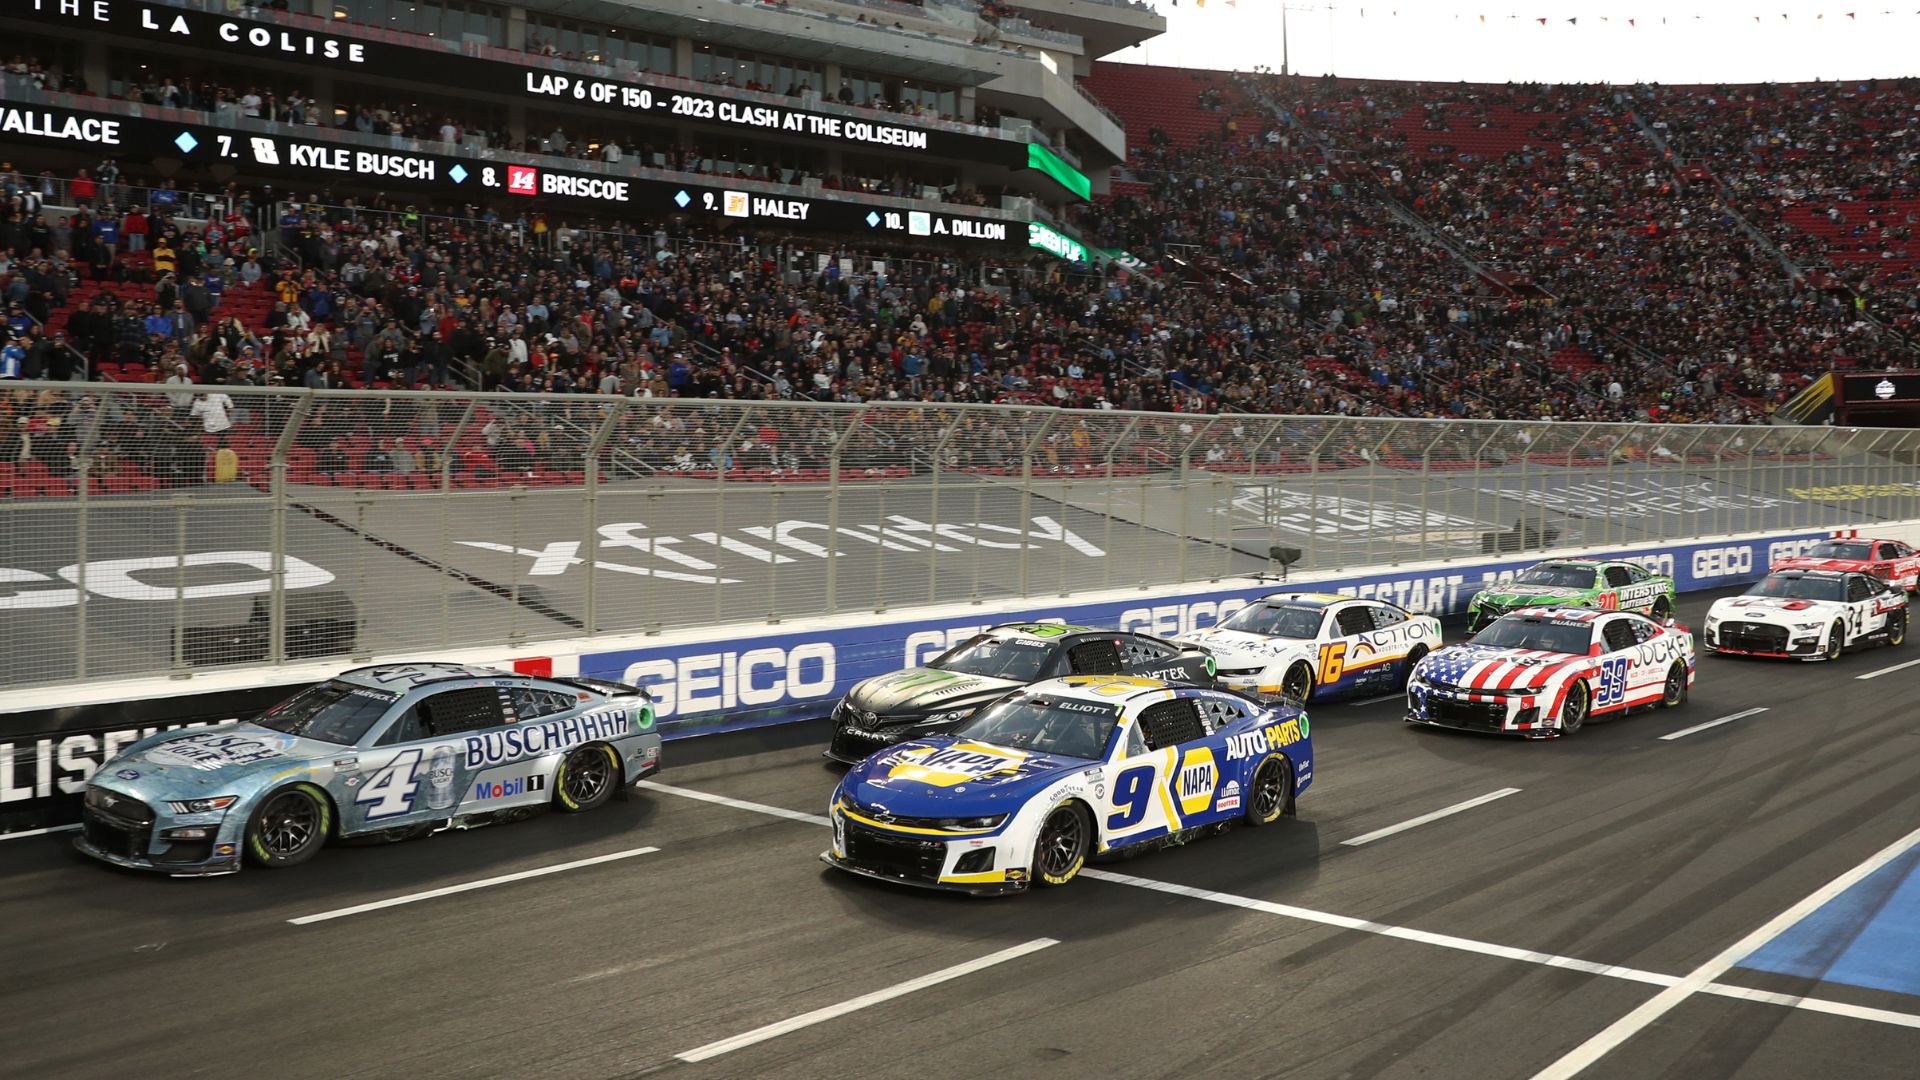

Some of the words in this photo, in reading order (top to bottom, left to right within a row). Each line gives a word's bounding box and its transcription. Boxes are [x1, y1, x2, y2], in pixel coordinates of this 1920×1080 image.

[142, 9, 190, 35] LA
[219, 22, 365, 63] COLISE
[526, 72, 569, 96] LAP
[573, 80, 585, 99] 6
[590, 83, 618, 103] OF
[621, 87, 652, 109] 150
[671, 95, 714, 119] 2023
[718, 102, 779, 128] CLASH
[783, 113, 805, 132] AT
[807, 115, 841, 137] THE
[844, 121, 927, 149] COLISEUM
[217, 135, 239, 158] 7.
[290, 144, 350, 171] KYLE
[356, 152, 435, 180] BUSCH
[482, 167, 500, 187] 8.
[509, 171, 534, 190] 14
[542, 173, 629, 201] BRISCOE
[703, 192, 718, 211] 9.
[753, 197, 810, 220] HALEY
[884, 212, 905, 230] 10.
[933, 217, 949, 235] A.
[952, 219, 1005, 240] DILLON
[1692, 545, 1752, 579] GEICO
[1620, 582, 1669, 601] INTERSTATE
[1846, 604, 1865, 637] 34
[1014, 639, 1047, 648] GIBBS
[622, 641, 836, 718] GEICO
[1318, 643, 1347, 685] 16
[1598, 657, 1627, 705] 99
[350, 689, 393, 701] HARVICK
[1058, 702, 1110, 715] ELLIOTT
[1225, 728, 1268, 761] AUTO
[1265, 718, 1301, 751] PARTS
[354, 748, 423, 819] 4
[476, 777, 523, 800] Mobil
[528, 775, 544, 792] 1
[1107, 765, 1156, 830] 9
[1183, 765, 1212, 797] NAPA
